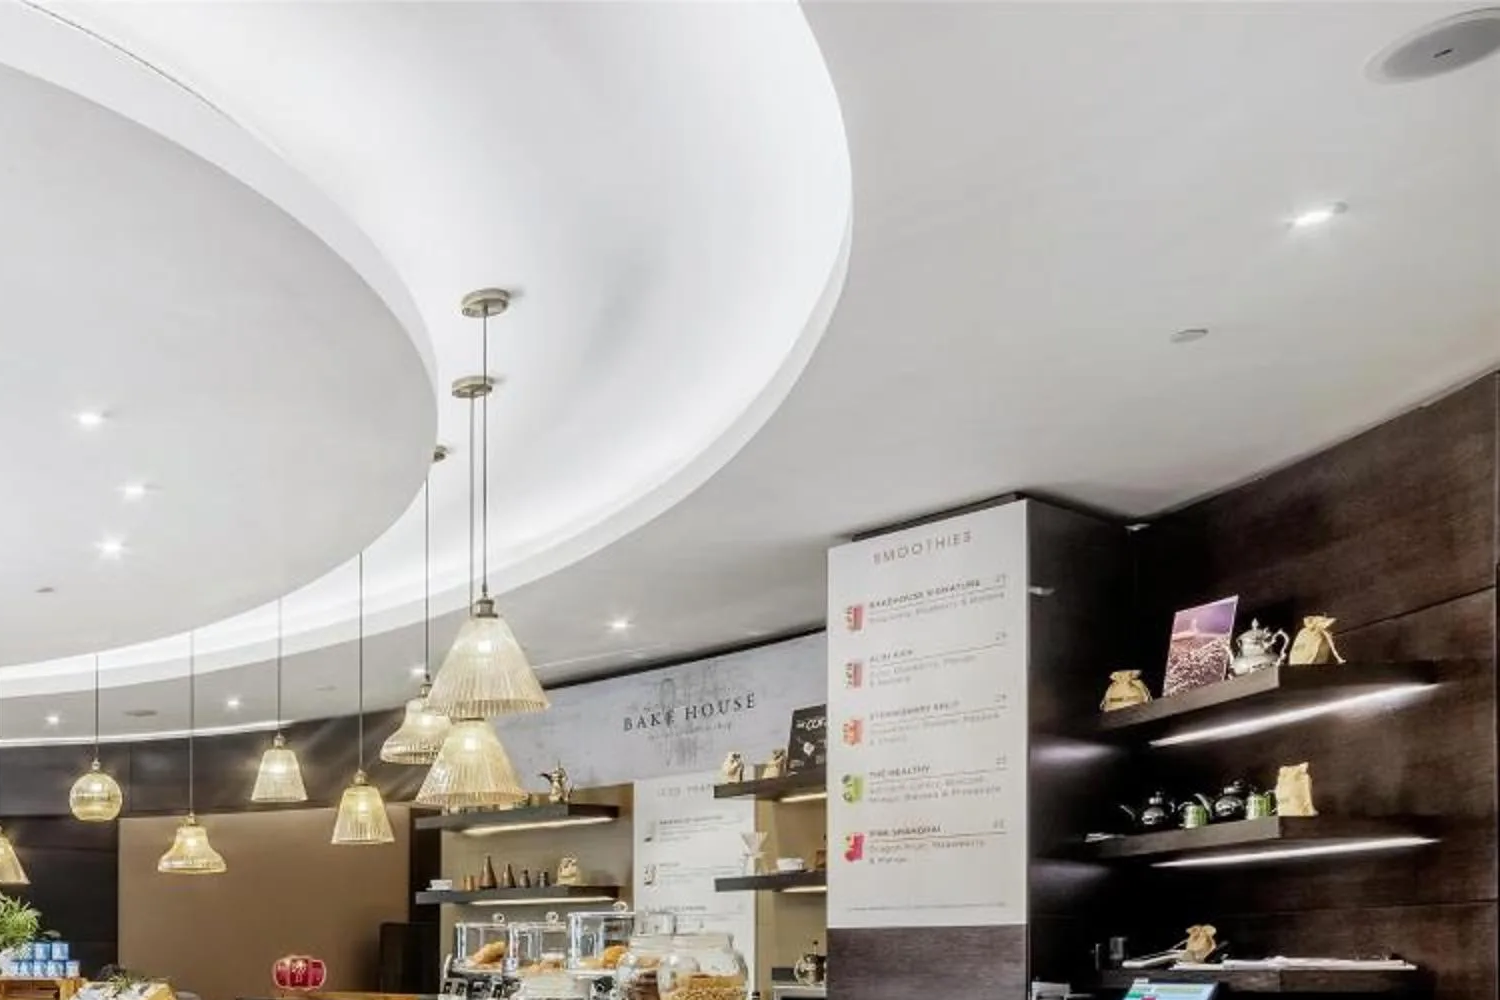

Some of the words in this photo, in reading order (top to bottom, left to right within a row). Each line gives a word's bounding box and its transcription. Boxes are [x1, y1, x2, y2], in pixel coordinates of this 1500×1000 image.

[874, 530, 972, 565] SMOOTHIES
[623, 708, 674, 732] BAKE
[685, 692, 756, 720] HOUSE
